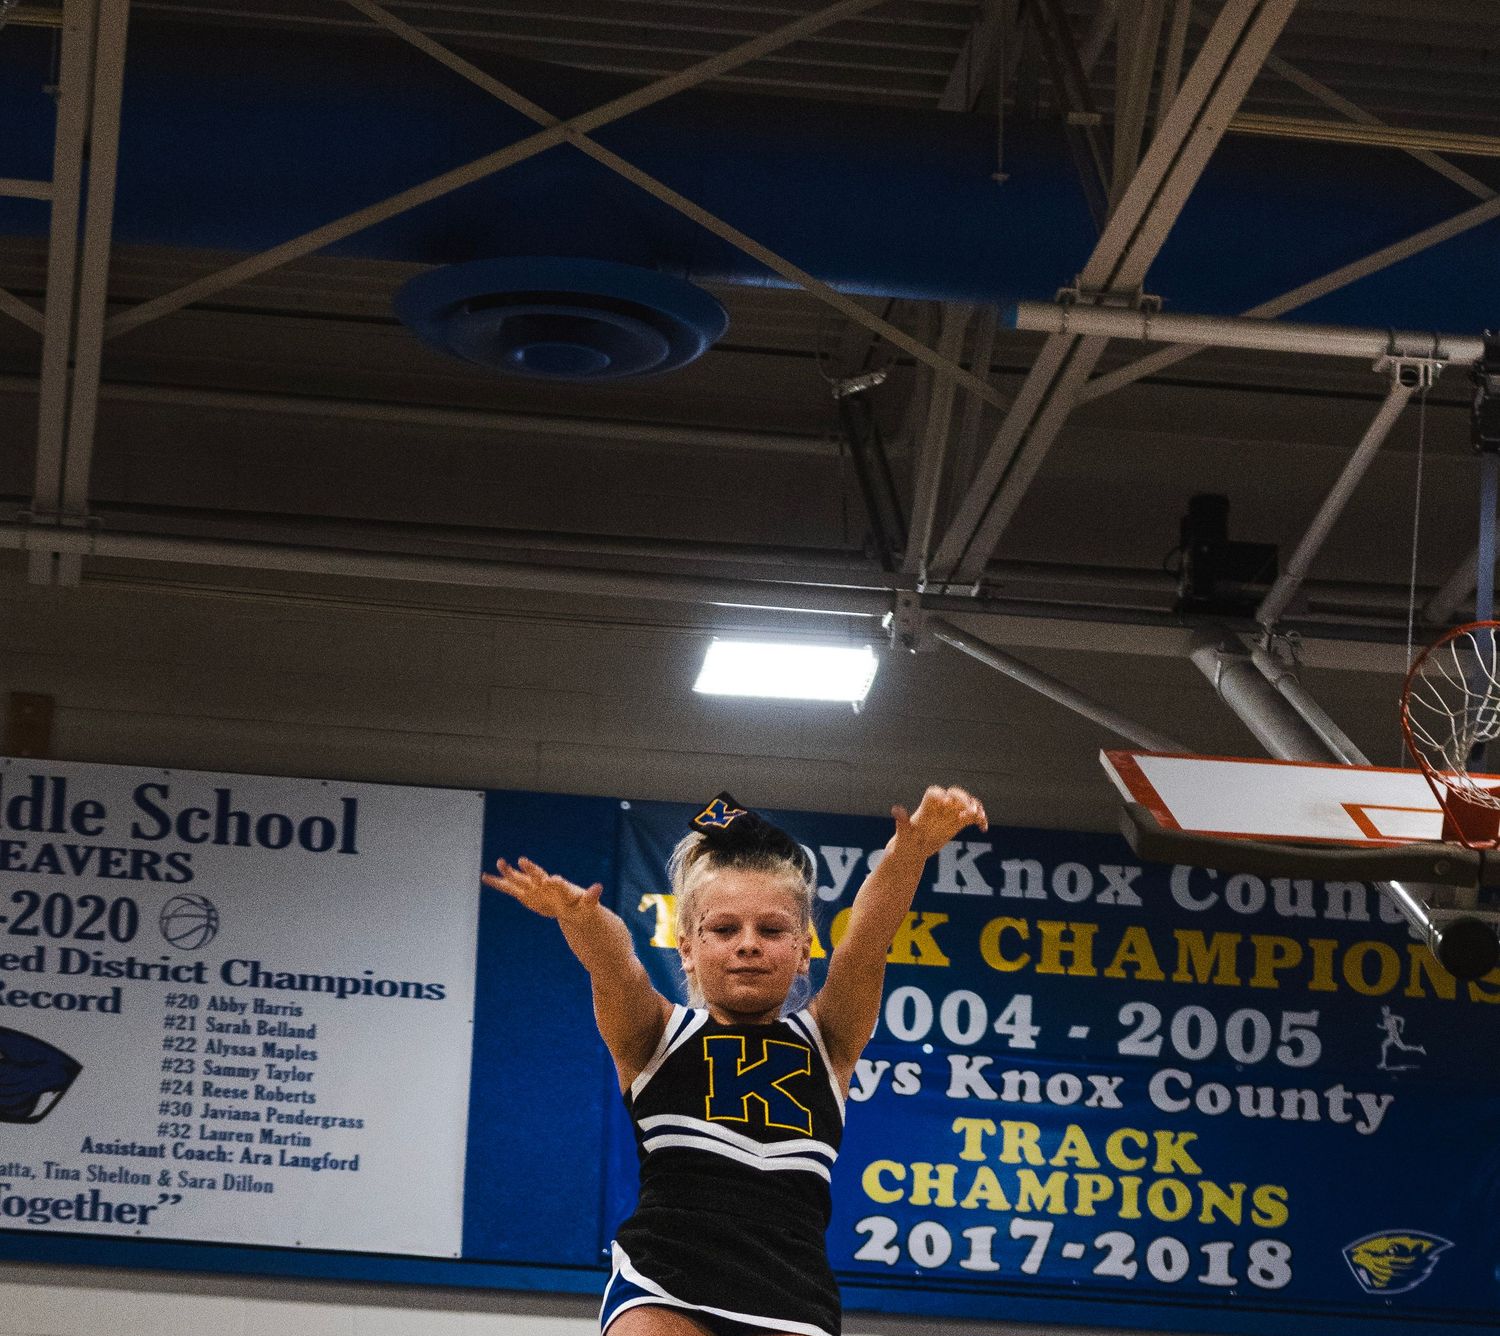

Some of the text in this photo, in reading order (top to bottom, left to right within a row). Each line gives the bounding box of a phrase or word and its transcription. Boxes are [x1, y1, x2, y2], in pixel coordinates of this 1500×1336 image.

[0, 775, 360, 855] dle School
[933, 841, 1142, 907] Knox
[57, 947, 208, 984] District
[220, 959, 446, 1000] Champions
[0, 980, 123, 1014] ecord
[164, 992, 303, 1017] #20 Abby Harris
[163, 1014, 317, 1040] #21 Sarah Belland
[868, 986, 1040, 1049] 004
[1117, 1001, 1322, 1062] 2005
[162, 1036, 318, 1062] #22 Alyssa Maples
[161, 1057, 315, 1083] #23 Sammy Taylor
[704, 1035, 812, 1136] K
[159, 1079, 317, 1105] #24 Reese Roberts
[946, 1054, 1124, 1109] Knox
[1148, 1068, 1394, 1135] County
[158, 1101, 364, 1130] #30 Javiana Pendergrass
[157, 1122, 312, 1148] #32 Lauren Martin
[951, 1117, 1202, 1176] TRACK
[80, 1136, 360, 1172] Assistant Coach: Ara Langford
[43, 1160, 81, 1182] Tina
[86, 1164, 151, 1186] Shelton
[157, 1169, 171, 1187] &
[178, 1170, 217, 1190] Sara
[861, 1160, 1289, 1229] CHAMPIONS
[854, 1216, 1293, 1290] 2017-2018
